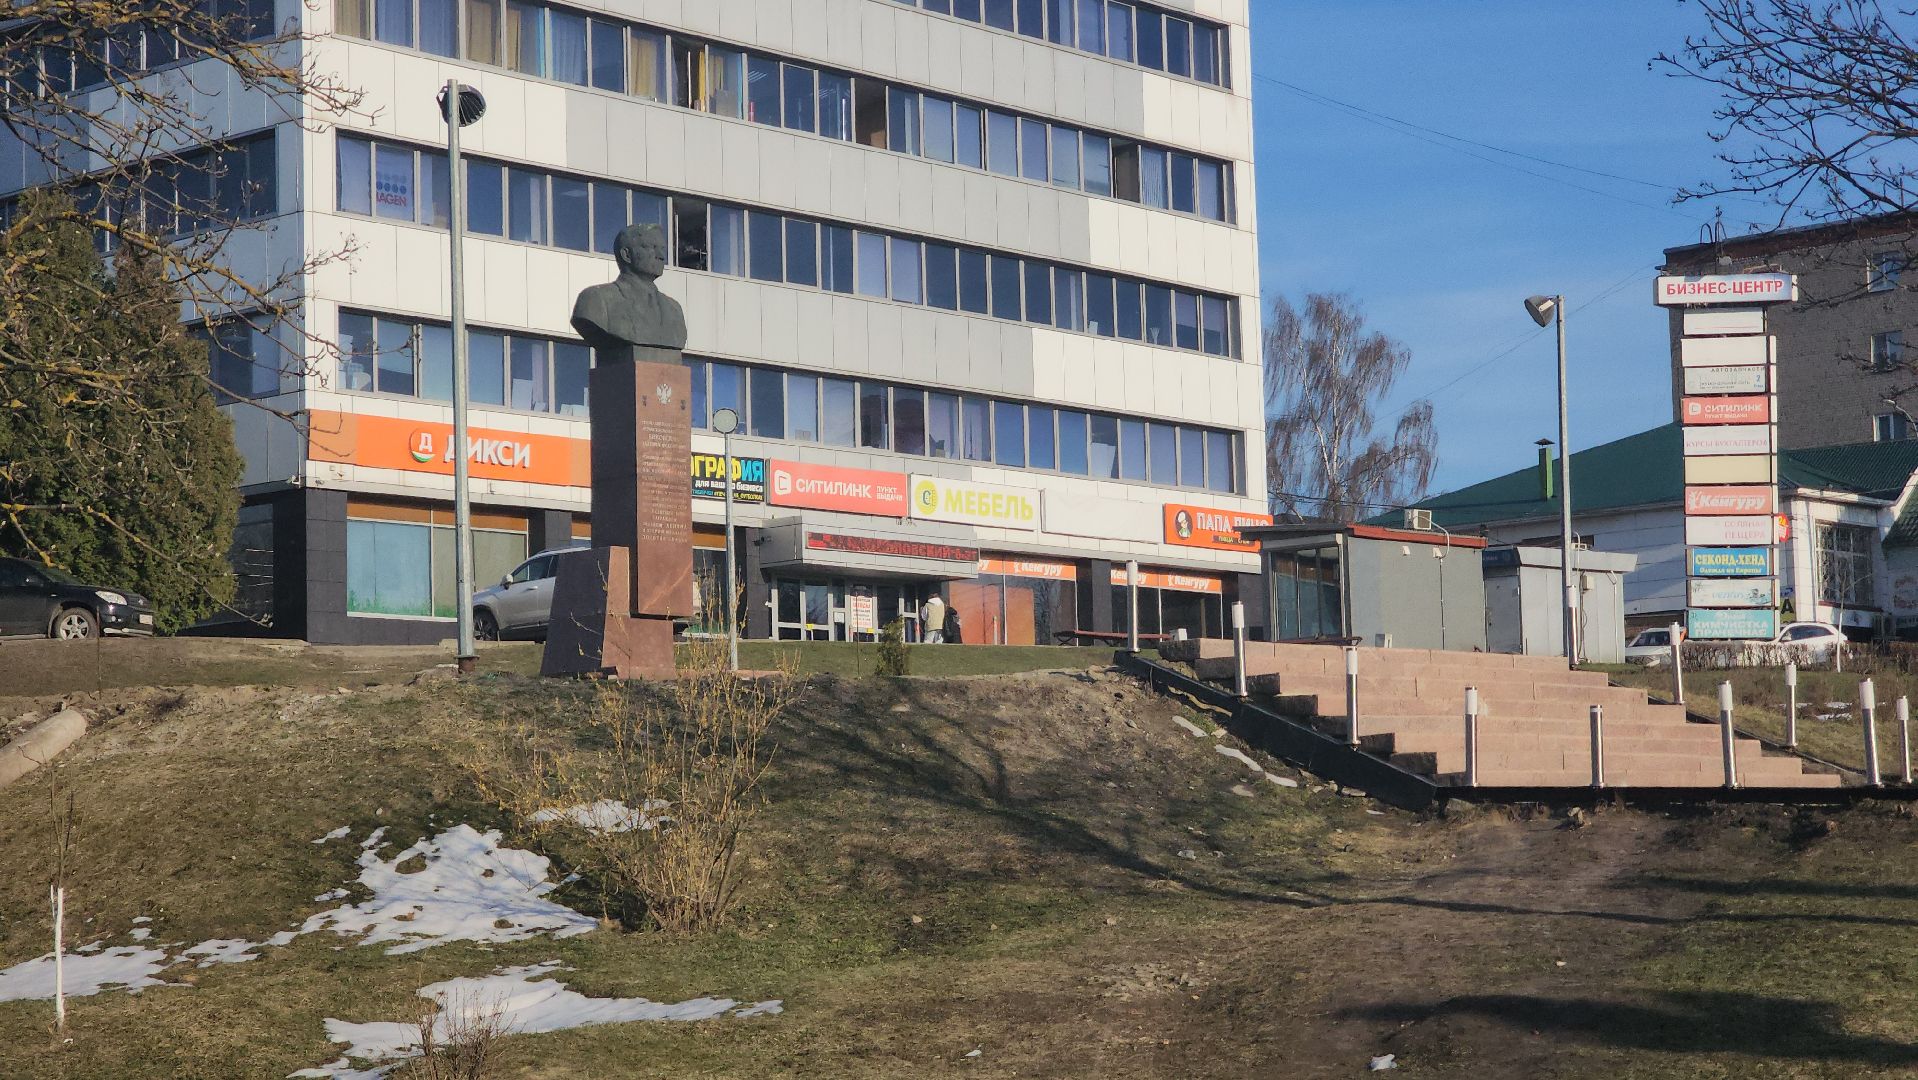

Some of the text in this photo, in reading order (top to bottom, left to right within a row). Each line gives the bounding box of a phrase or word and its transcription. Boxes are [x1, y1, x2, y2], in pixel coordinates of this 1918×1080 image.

[1666, 280, 1783, 295] БИЗНЕС-ЦЕНТР
[1704, 404, 1762, 413] СИТИЛИНК
[695, 480, 763, 492] для вашо бизнеса
[795, 478, 872, 499] СИТИЛИНК
[876, 485, 897, 494] ПУНКТ
[876, 493, 903, 501] ВЫДАЧИ
[944, 488, 1034, 521] МЕБЕЛЬ
[1196, 512, 1231, 532] ПАПА
[1696, 554, 1766, 565] СЕКОНД-ХЕНД
[1021, 561, 1062, 576] Кенгуру
[1111, 569, 1147, 584] Кенру
[1175, 575, 1210, 590] Кенгуру
[1694, 621, 1768, 629] ХИМЧИСТКА
[1695, 628, 1766, 637] ПРАЧЕЧНАЯ
